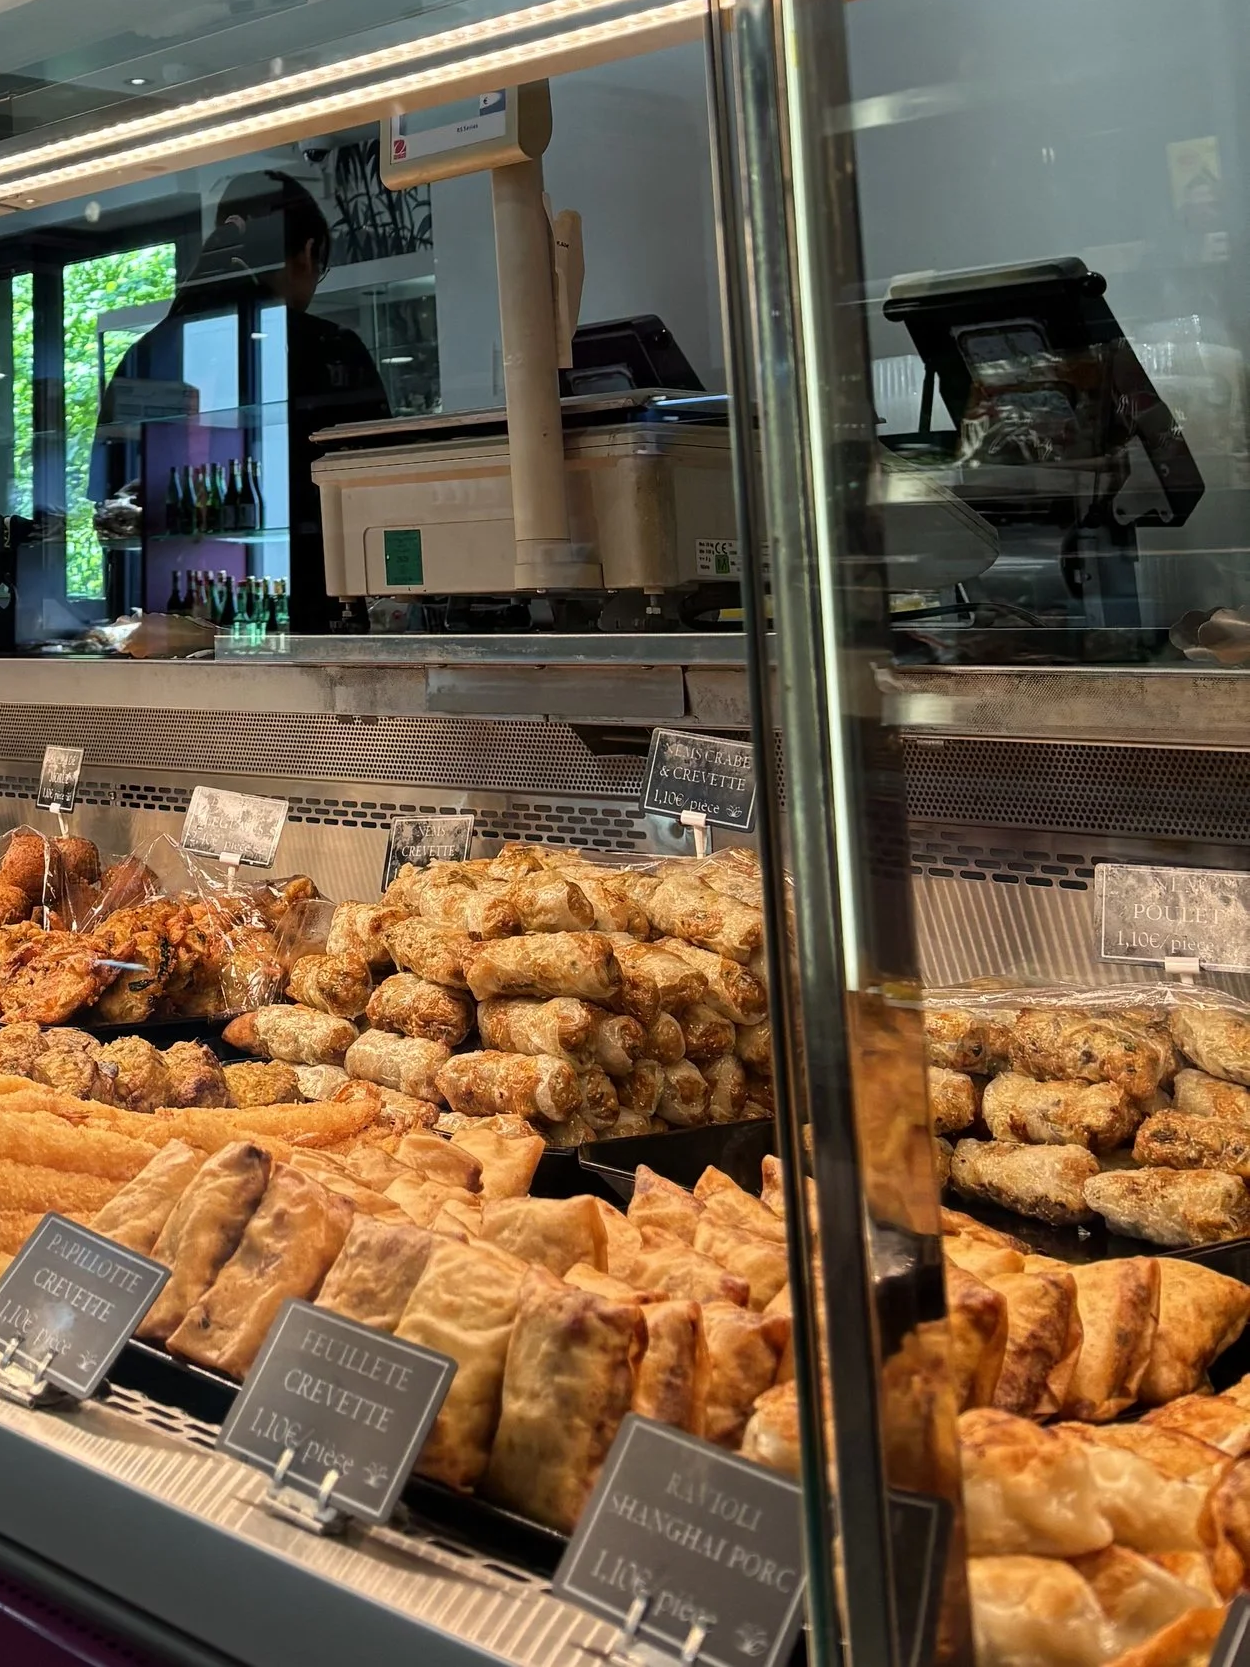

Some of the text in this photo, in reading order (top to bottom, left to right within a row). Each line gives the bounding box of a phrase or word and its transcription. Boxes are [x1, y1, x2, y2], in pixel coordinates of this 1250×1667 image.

[659, 765, 747, 791] & CREVETTE
[664, 743, 754, 769] NEMS CRABE
[401, 844, 456, 857] CREVETTE
[1133, 903, 1224, 925] POULET
[47, 1233, 143, 1294] PAPILLOTTE
[33, 1266, 116, 1323] CREVETTE
[301, 1329, 413, 1392] FEUILLETE
[284, 1368, 394, 1433] CREVETTE
[664, 1472, 763, 1532] RAVIOLI
[609, 1491, 796, 1594] SHANGHAI PORC
